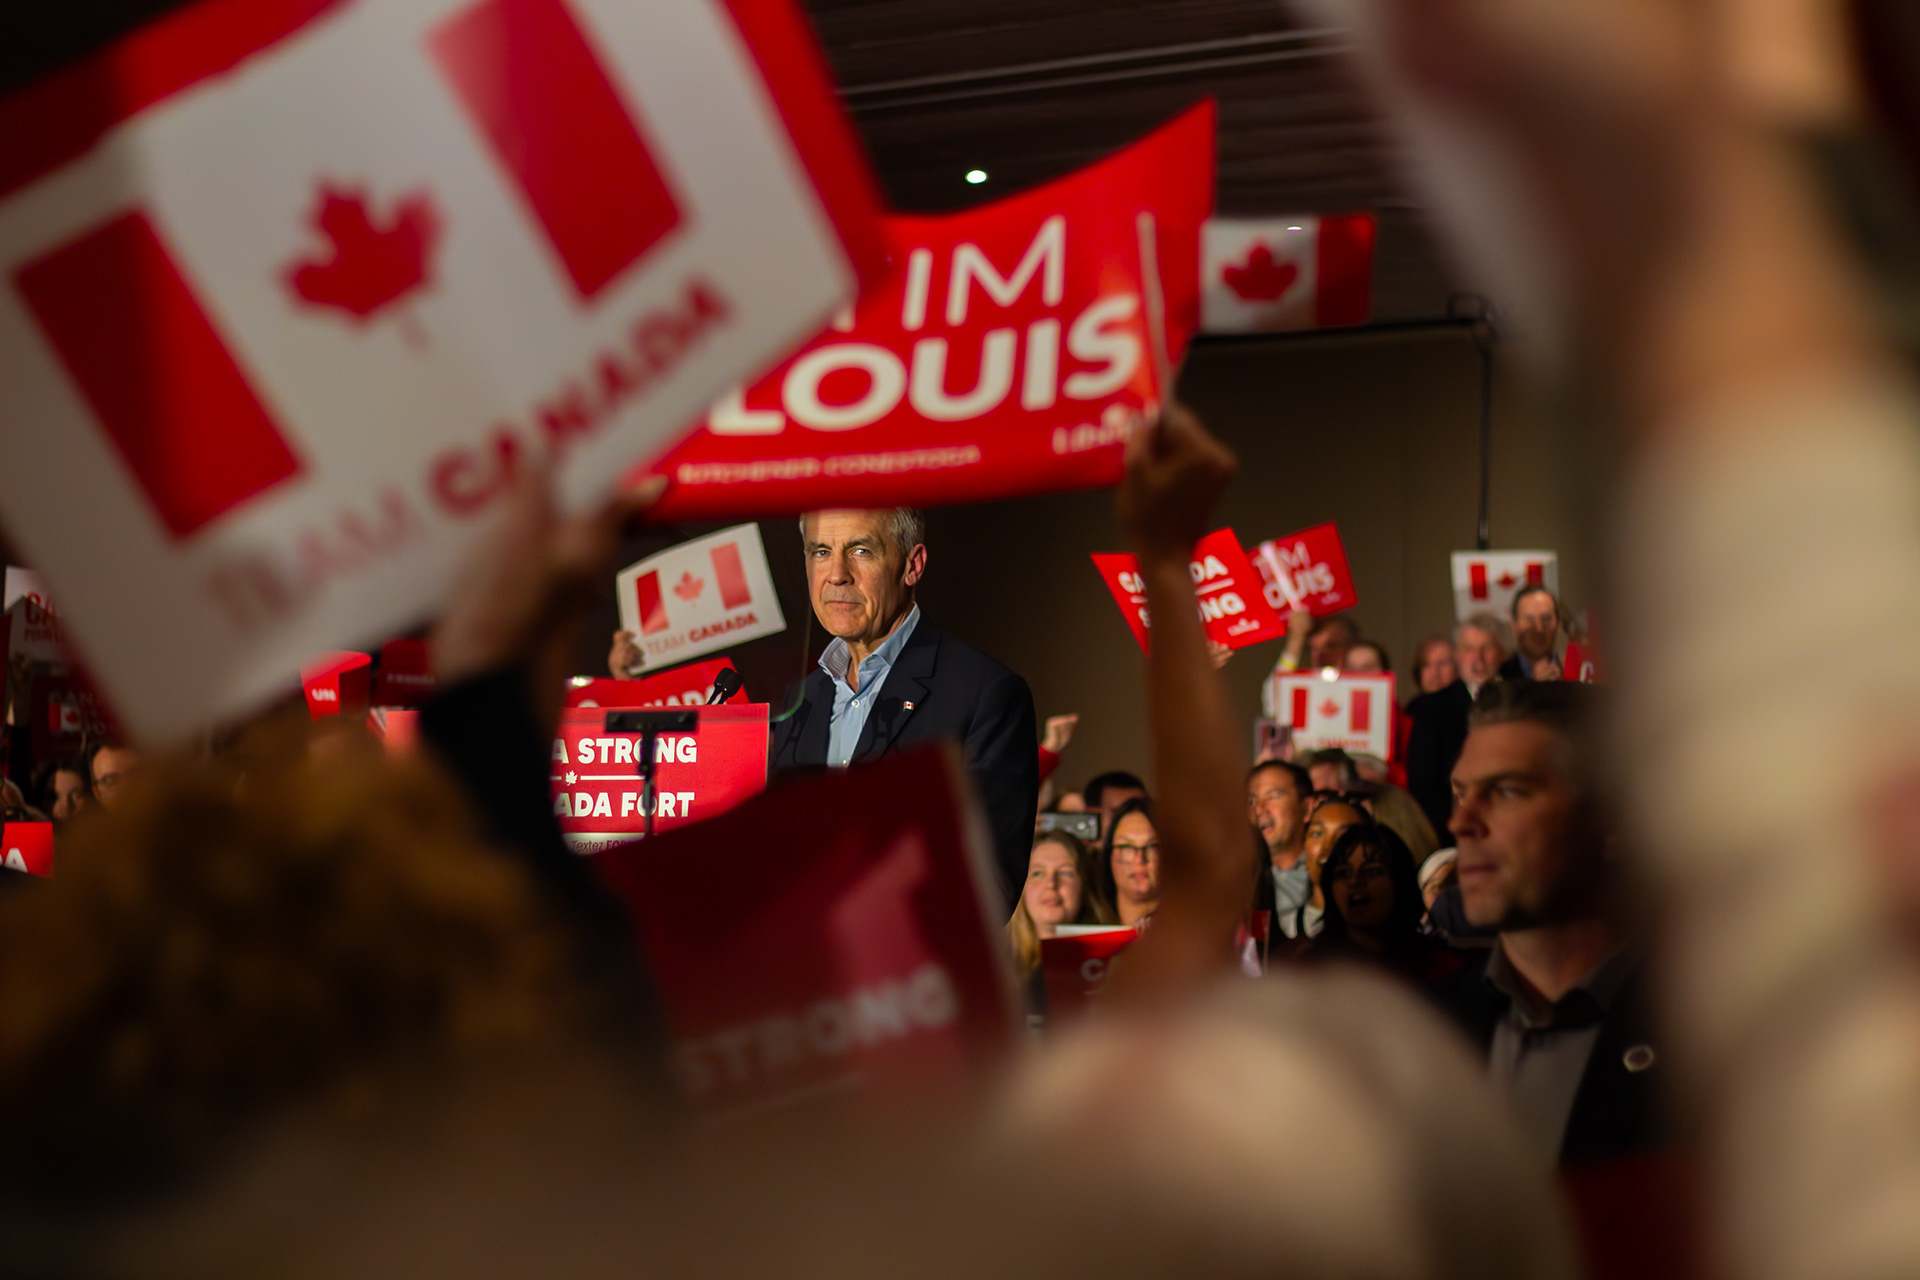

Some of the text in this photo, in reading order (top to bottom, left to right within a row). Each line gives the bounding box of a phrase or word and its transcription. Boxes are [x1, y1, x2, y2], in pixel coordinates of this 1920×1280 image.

[834, 213, 1067, 333] IM
[646, 612, 758, 656] TEAM CANADA
[621, 792, 695, 817] FORT
